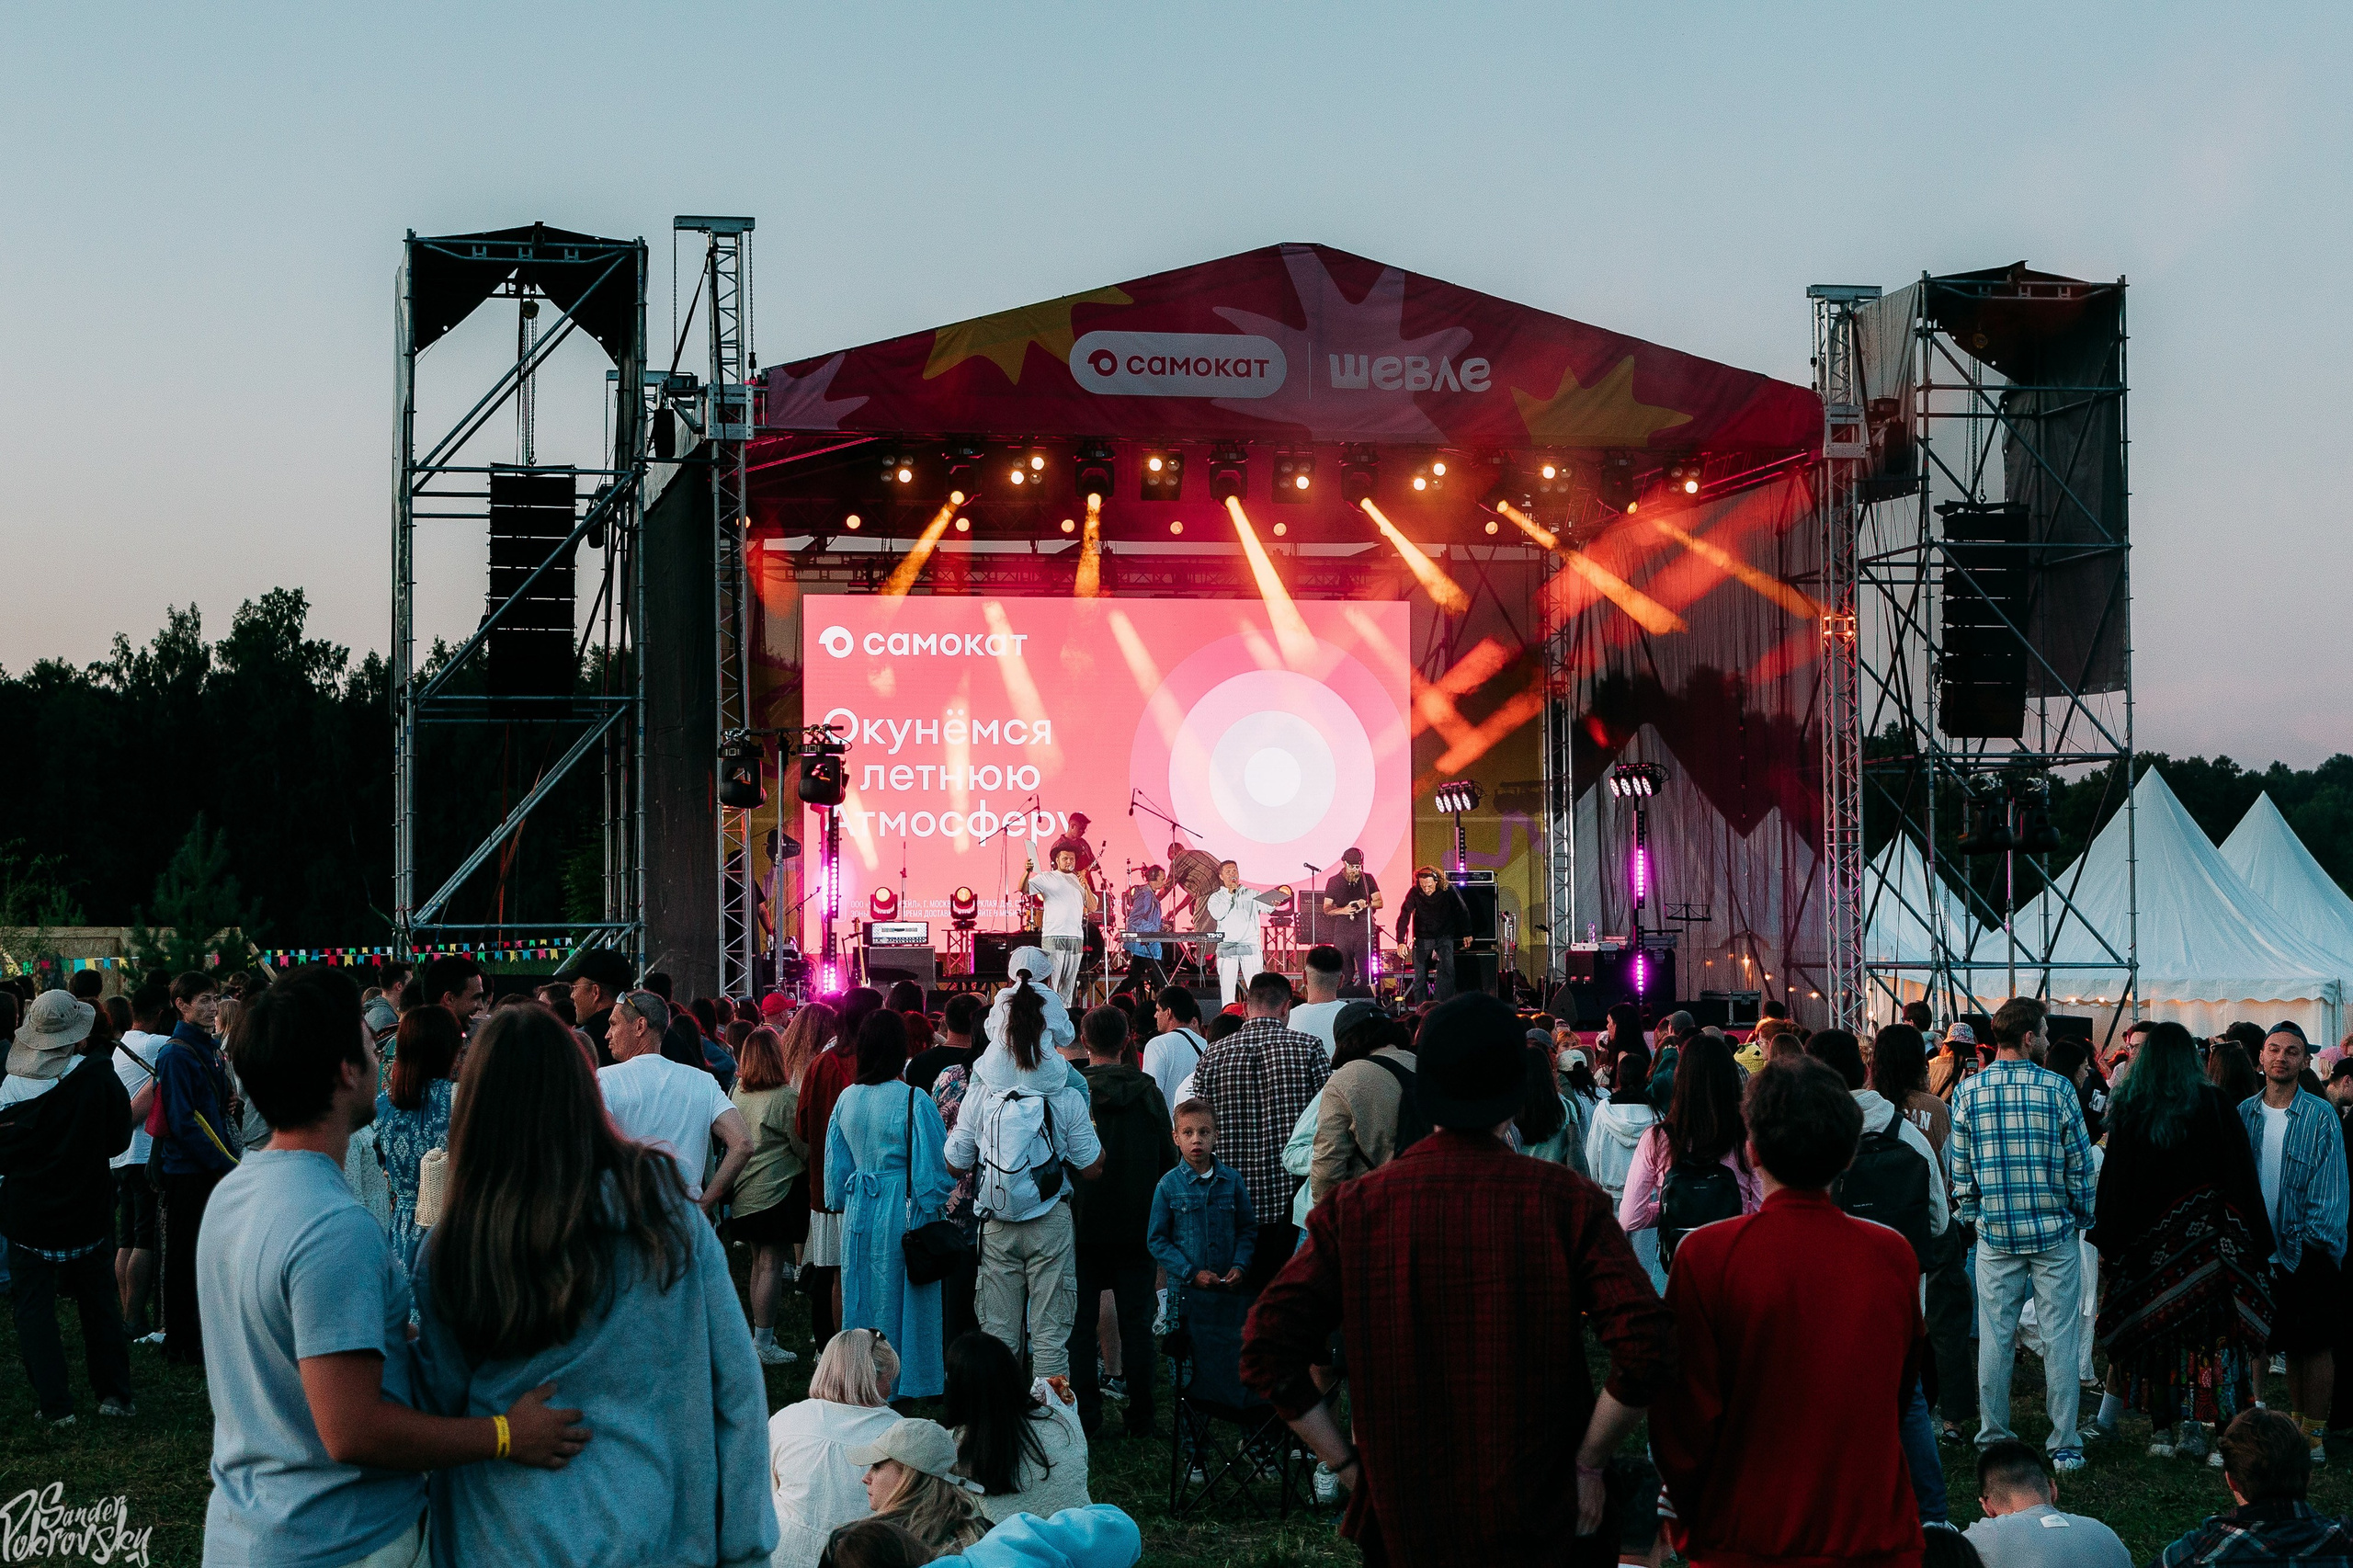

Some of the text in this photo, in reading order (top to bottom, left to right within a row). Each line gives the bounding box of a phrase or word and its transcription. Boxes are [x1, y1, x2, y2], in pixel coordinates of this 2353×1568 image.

[1126, 355, 1270, 379] самокат
[863, 632, 1028, 656] самокат
[823, 708, 1051, 755] Окунёмся
[860, 765, 1040, 790] летнюю
[929, 900, 951, 908] МОСКВ
